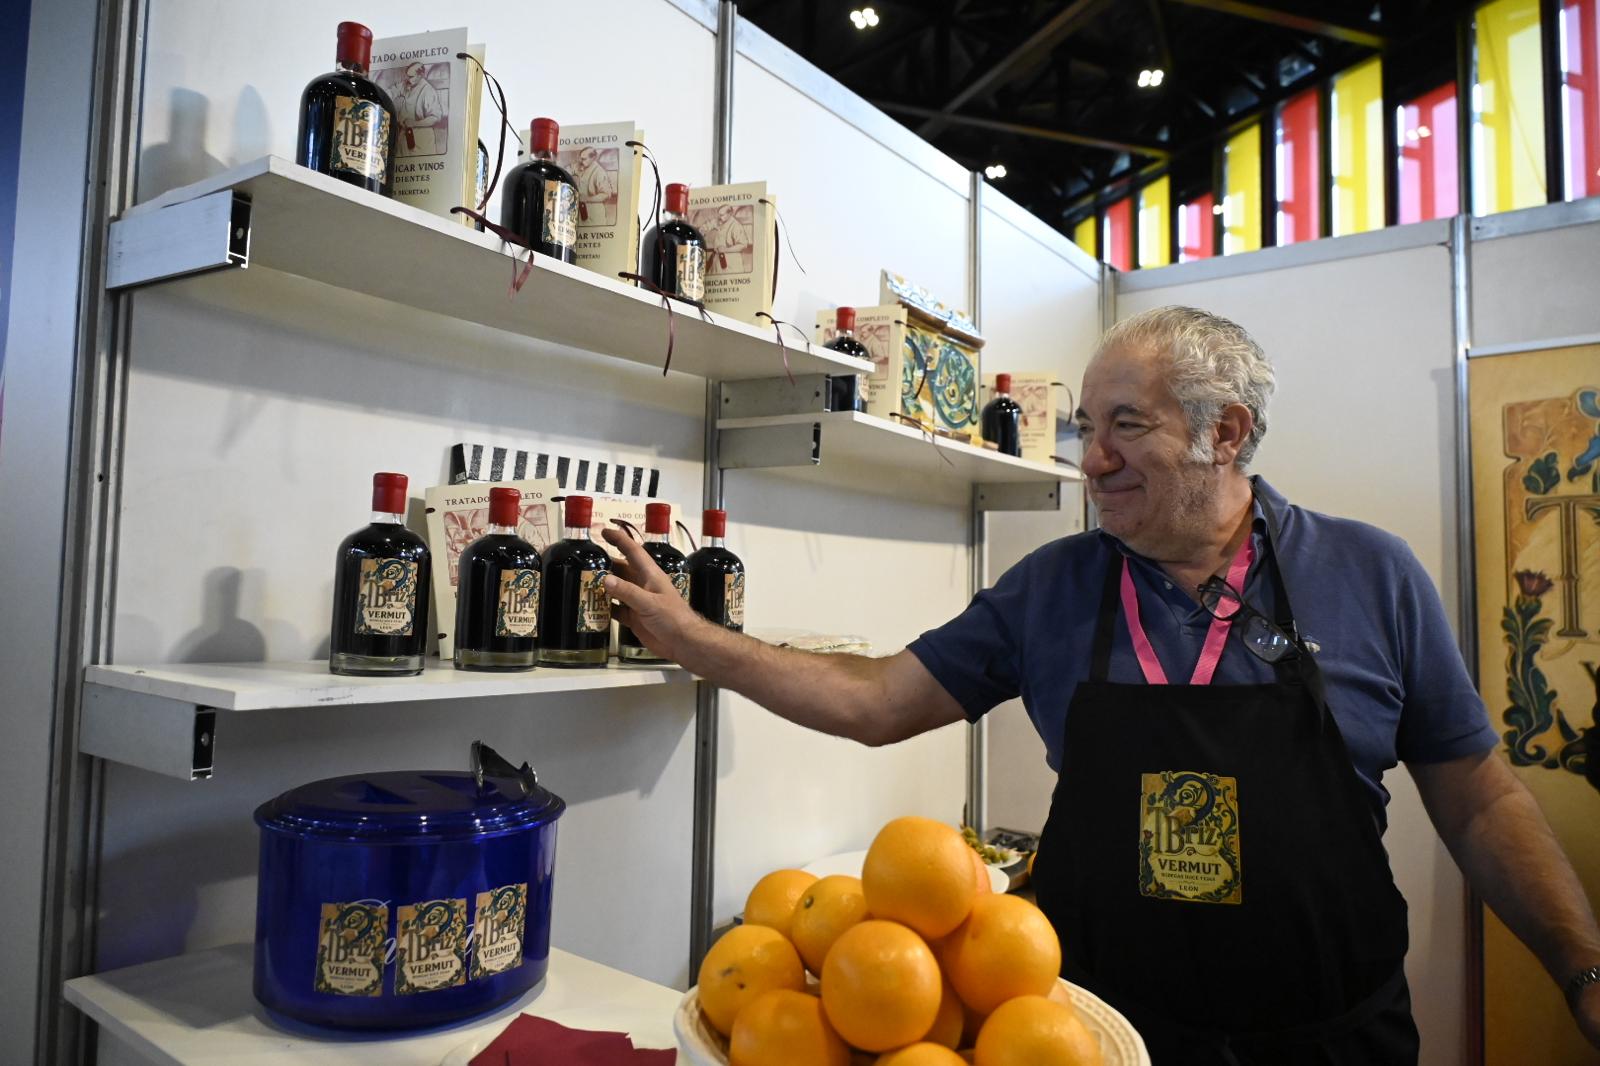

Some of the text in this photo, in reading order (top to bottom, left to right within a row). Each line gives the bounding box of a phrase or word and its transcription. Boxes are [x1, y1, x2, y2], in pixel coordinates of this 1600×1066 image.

[372, 46, 449, 64] TADO COMPLETO
[573, 134, 618, 144] COMPLETO
[395, 162, 445, 173] ICAR VINOS
[395, 174, 431, 183] DIENTES
[712, 193, 752, 203] COMPLETO
[590, 231, 615, 240] VINOS
[730, 277, 751, 285] VINOS
[705, 286, 740, 294] ARDIENTES
[445, 497, 489, 506] TRATADO
[368, 610, 406, 620] VERMUT
[508, 616, 535, 624] VERMUT
[1158, 858, 1222, 876] VERMUT
[483, 942, 517, 959] VERMUT
[329, 965, 371, 978] VERMUT
[410, 960, 454, 974] VERMUT
